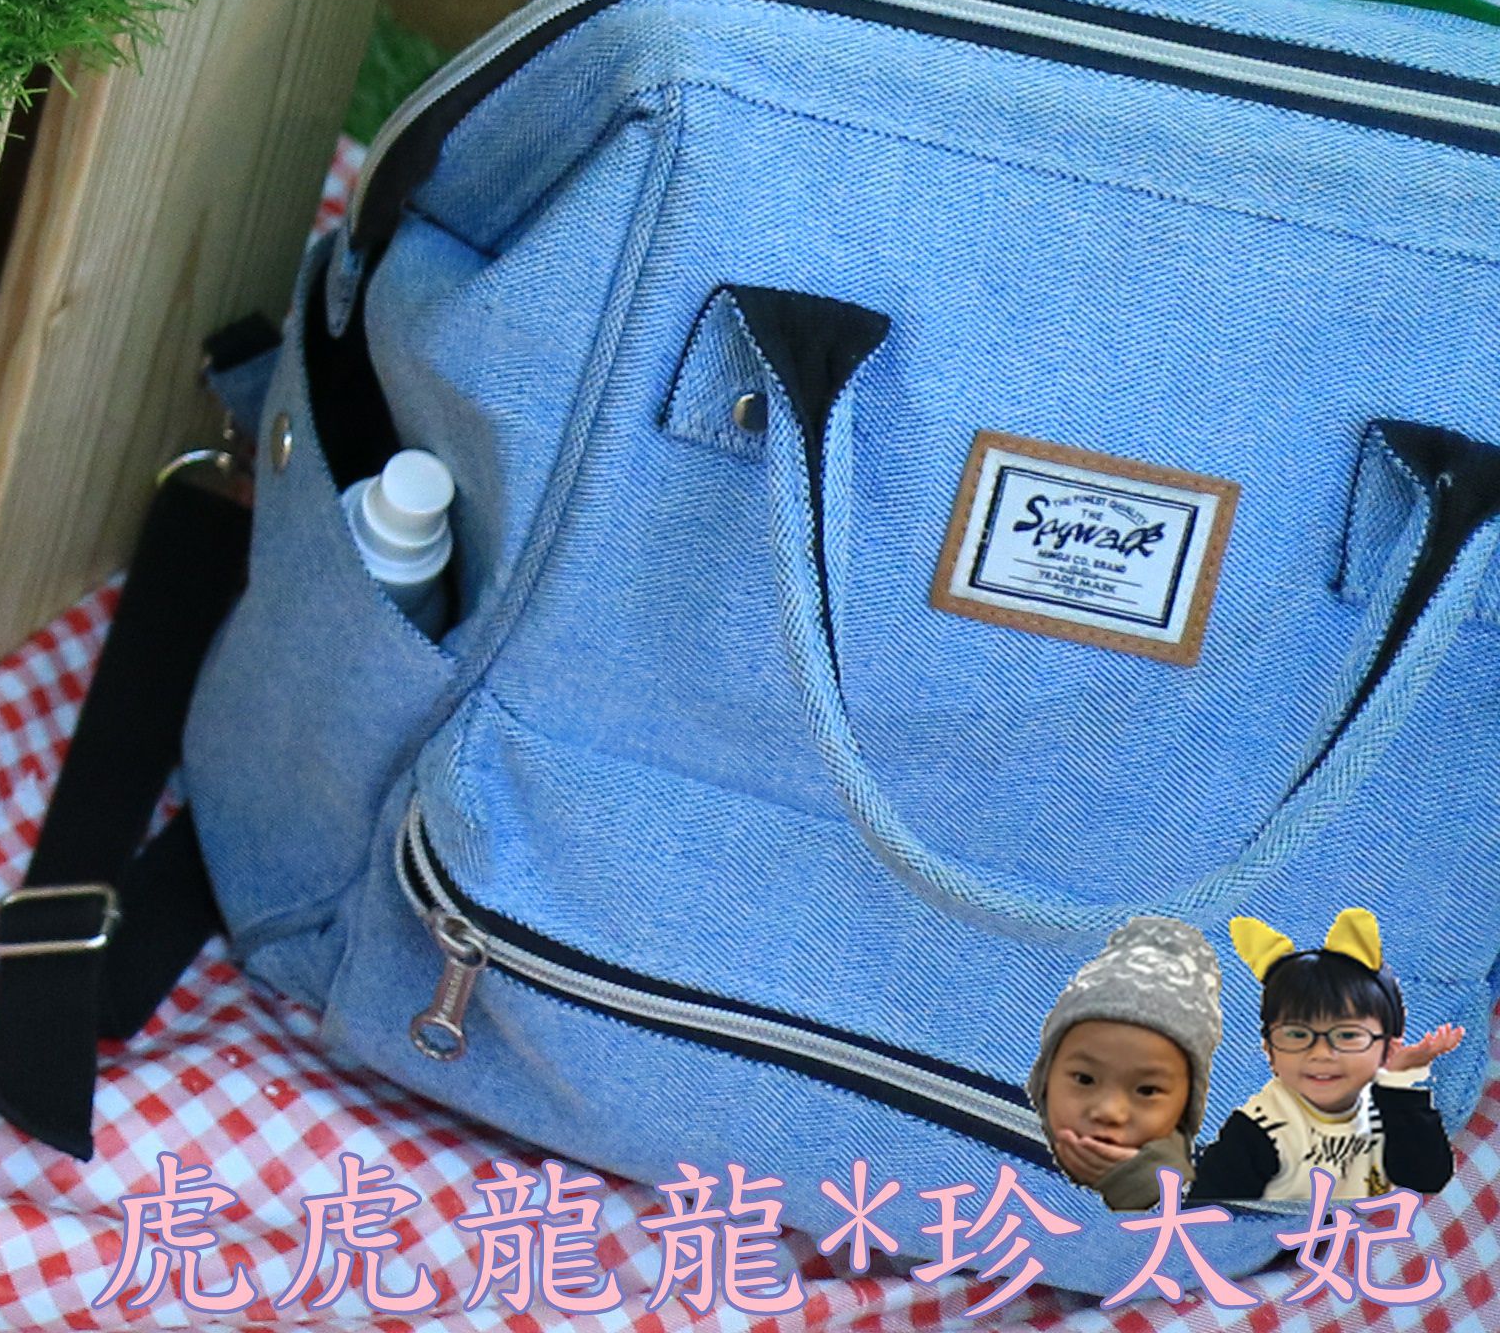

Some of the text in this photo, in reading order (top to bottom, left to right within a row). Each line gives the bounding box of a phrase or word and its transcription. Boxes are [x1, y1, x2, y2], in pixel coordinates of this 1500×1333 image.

[1052, 494, 1150, 526] THE FINEST QUALITY
[1081, 507, 1104, 522] THE
[1093, 557, 1127, 575] BRAND
[1038, 569, 1118, 594] TRADE MARK
